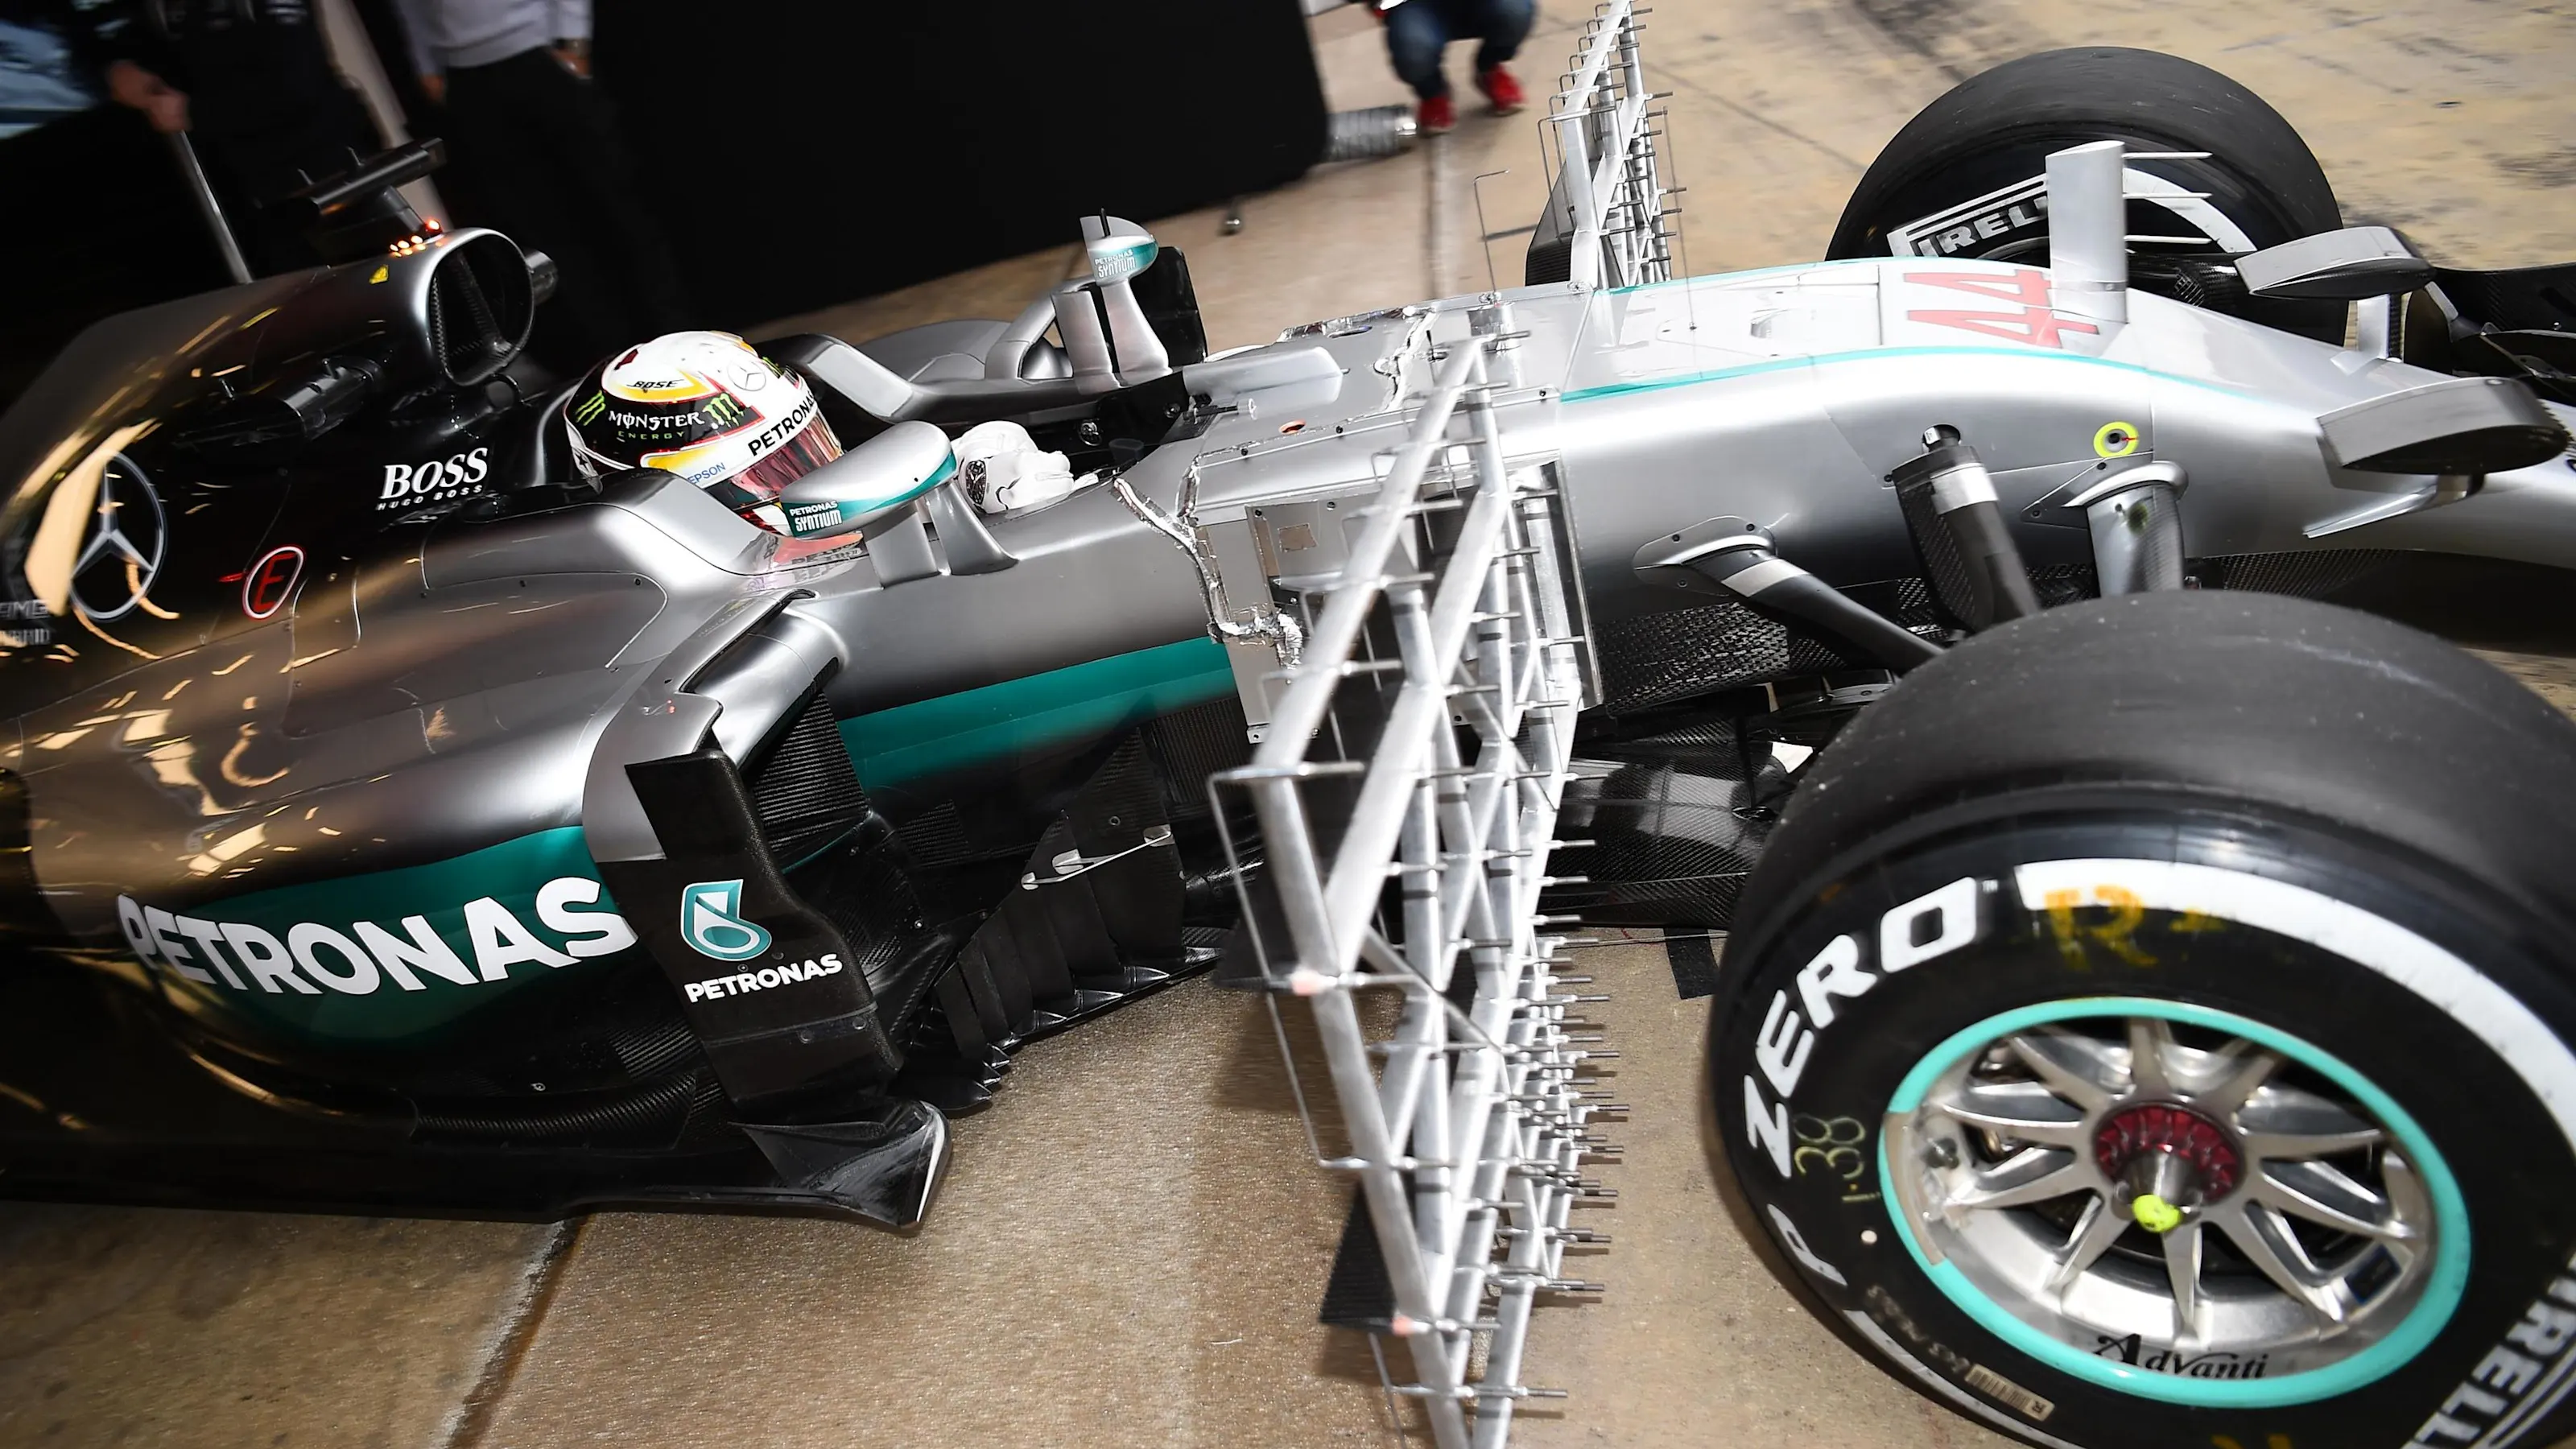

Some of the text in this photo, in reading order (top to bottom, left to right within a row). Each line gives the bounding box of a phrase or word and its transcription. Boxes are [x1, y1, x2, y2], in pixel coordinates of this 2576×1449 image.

[1095, 249, 1133, 265] PETRONAS
[1098, 258, 1136, 278] SYNTIUM
[1904, 269, 2099, 349] 44
[627, 379, 684, 389] BOSE
[609, 410, 705, 431] MONSTER
[617, 431, 685, 441] ENERGY
[379, 447, 488, 499] BOSS
[687, 462, 726, 484] EPSON
[375, 485, 482, 510] HUGO BOSS
[790, 501, 838, 517] PETRONAS
[795, 510, 842, 532] SYNTIUM
[254, 552, 298, 611] E
[117, 877, 639, 995] PETRONAS
[684, 954, 843, 1003] PETRONAS
[1744, 877, 1977, 1179] ZERO
[1767, 1203, 1847, 1286] P
[2093, 1333, 2268, 1379] Advanti
